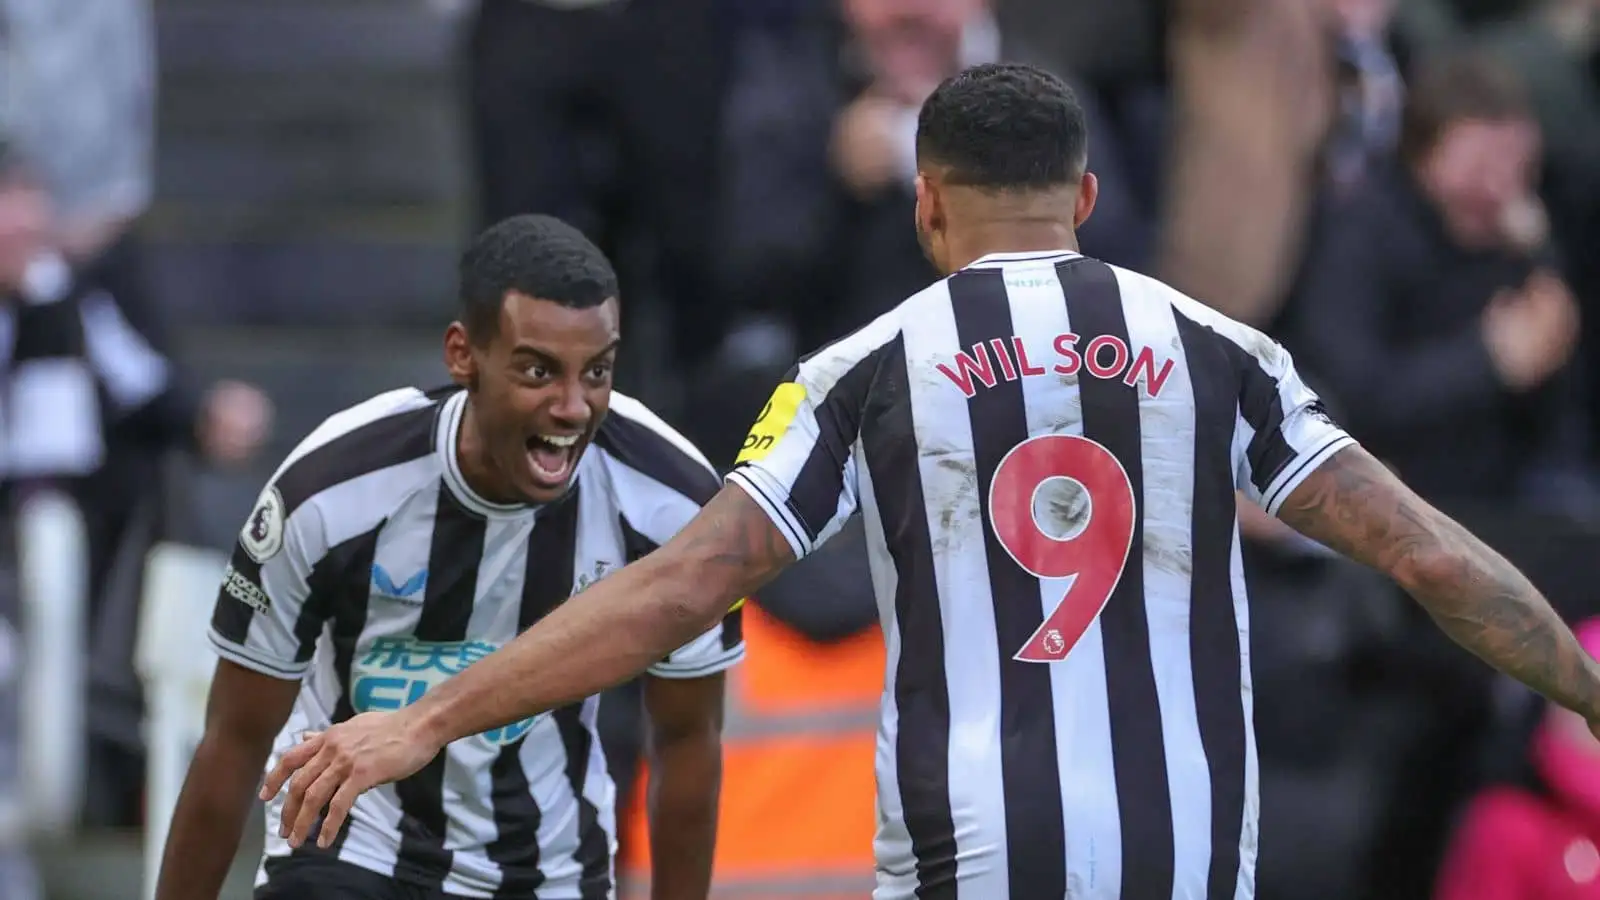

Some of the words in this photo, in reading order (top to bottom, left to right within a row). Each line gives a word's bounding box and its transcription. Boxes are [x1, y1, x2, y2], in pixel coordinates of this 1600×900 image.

[935, 332, 1176, 398] WILSON
[742, 433, 775, 450] on
[988, 433, 1137, 663] 9
